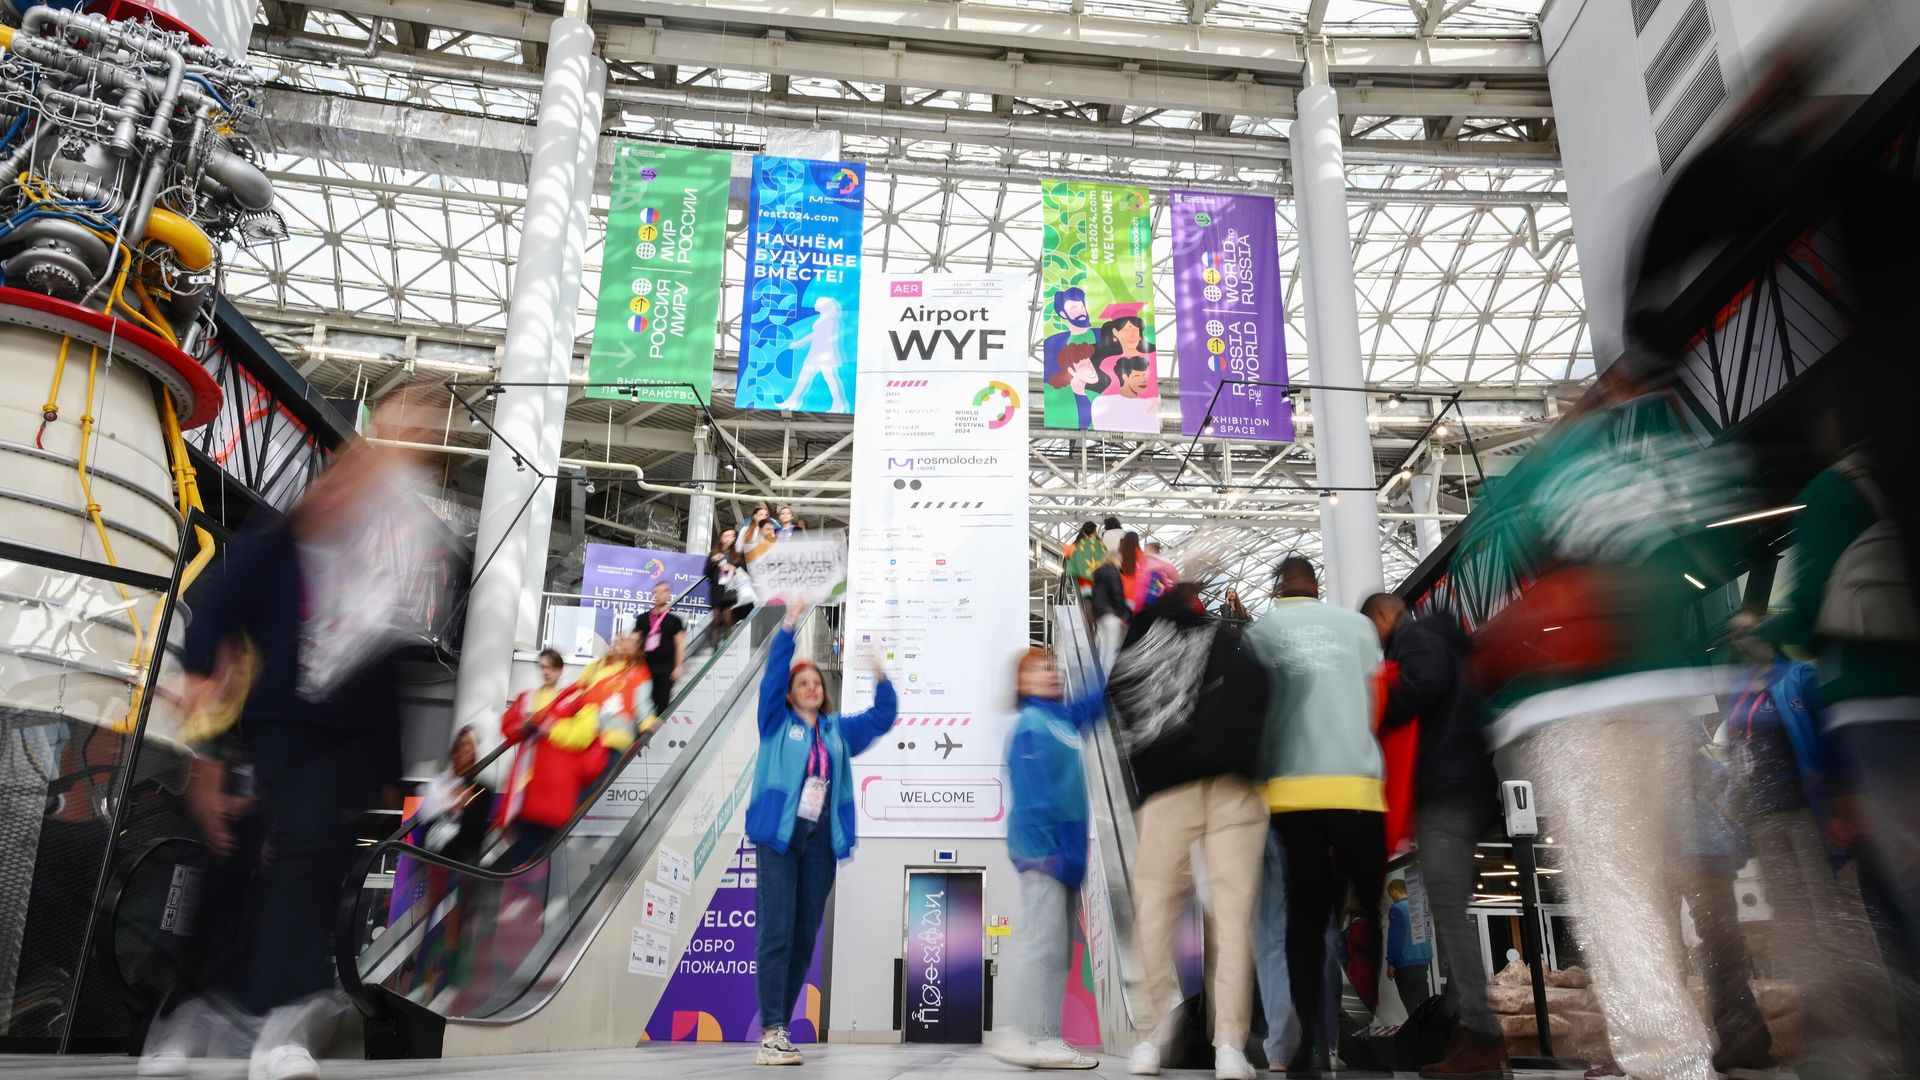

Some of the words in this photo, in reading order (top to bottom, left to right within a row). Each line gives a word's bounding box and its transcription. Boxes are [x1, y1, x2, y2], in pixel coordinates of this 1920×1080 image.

[677, 187, 699, 264] РОССИИ
[758, 209, 839, 223] fest2024.com
[1088, 190, 1099, 265] fest2024.com
[1101, 190, 1115, 265] WELCOME!
[660, 219, 677, 262] МИР
[756, 232, 844, 250] НАЧНЁМ
[755, 248, 857, 268] БУДУЩЕЕ
[753, 265, 844, 283] ВМЕСТЕ!
[1223, 239, 1240, 303] WORLD
[1238, 234, 1255, 305] RUSSIA
[894, 284, 919, 293] AER
[649, 279, 671, 358] РОССИЯ
[670, 280, 688, 337] МИРУ
[900, 305, 989, 326] Airport
[888, 329, 1006, 361] WYF
[1244, 322, 1260, 387] WORLD
[1228, 321, 1246, 396] RUSSIA
[602, 386, 695, 400] ПРРАНСТВО
[1212, 416, 1270, 426] XHIBITION
[1220, 425, 1256, 435] SPACE
[917, 455, 998, 465] rosmolodezh
[594, 586, 631, 599] LET'S
[636, 589, 678, 604] STAT
[683, 595, 706, 605] THE
[900, 791, 975, 803] WELCOME
[702, 910, 756, 928] ELCO
